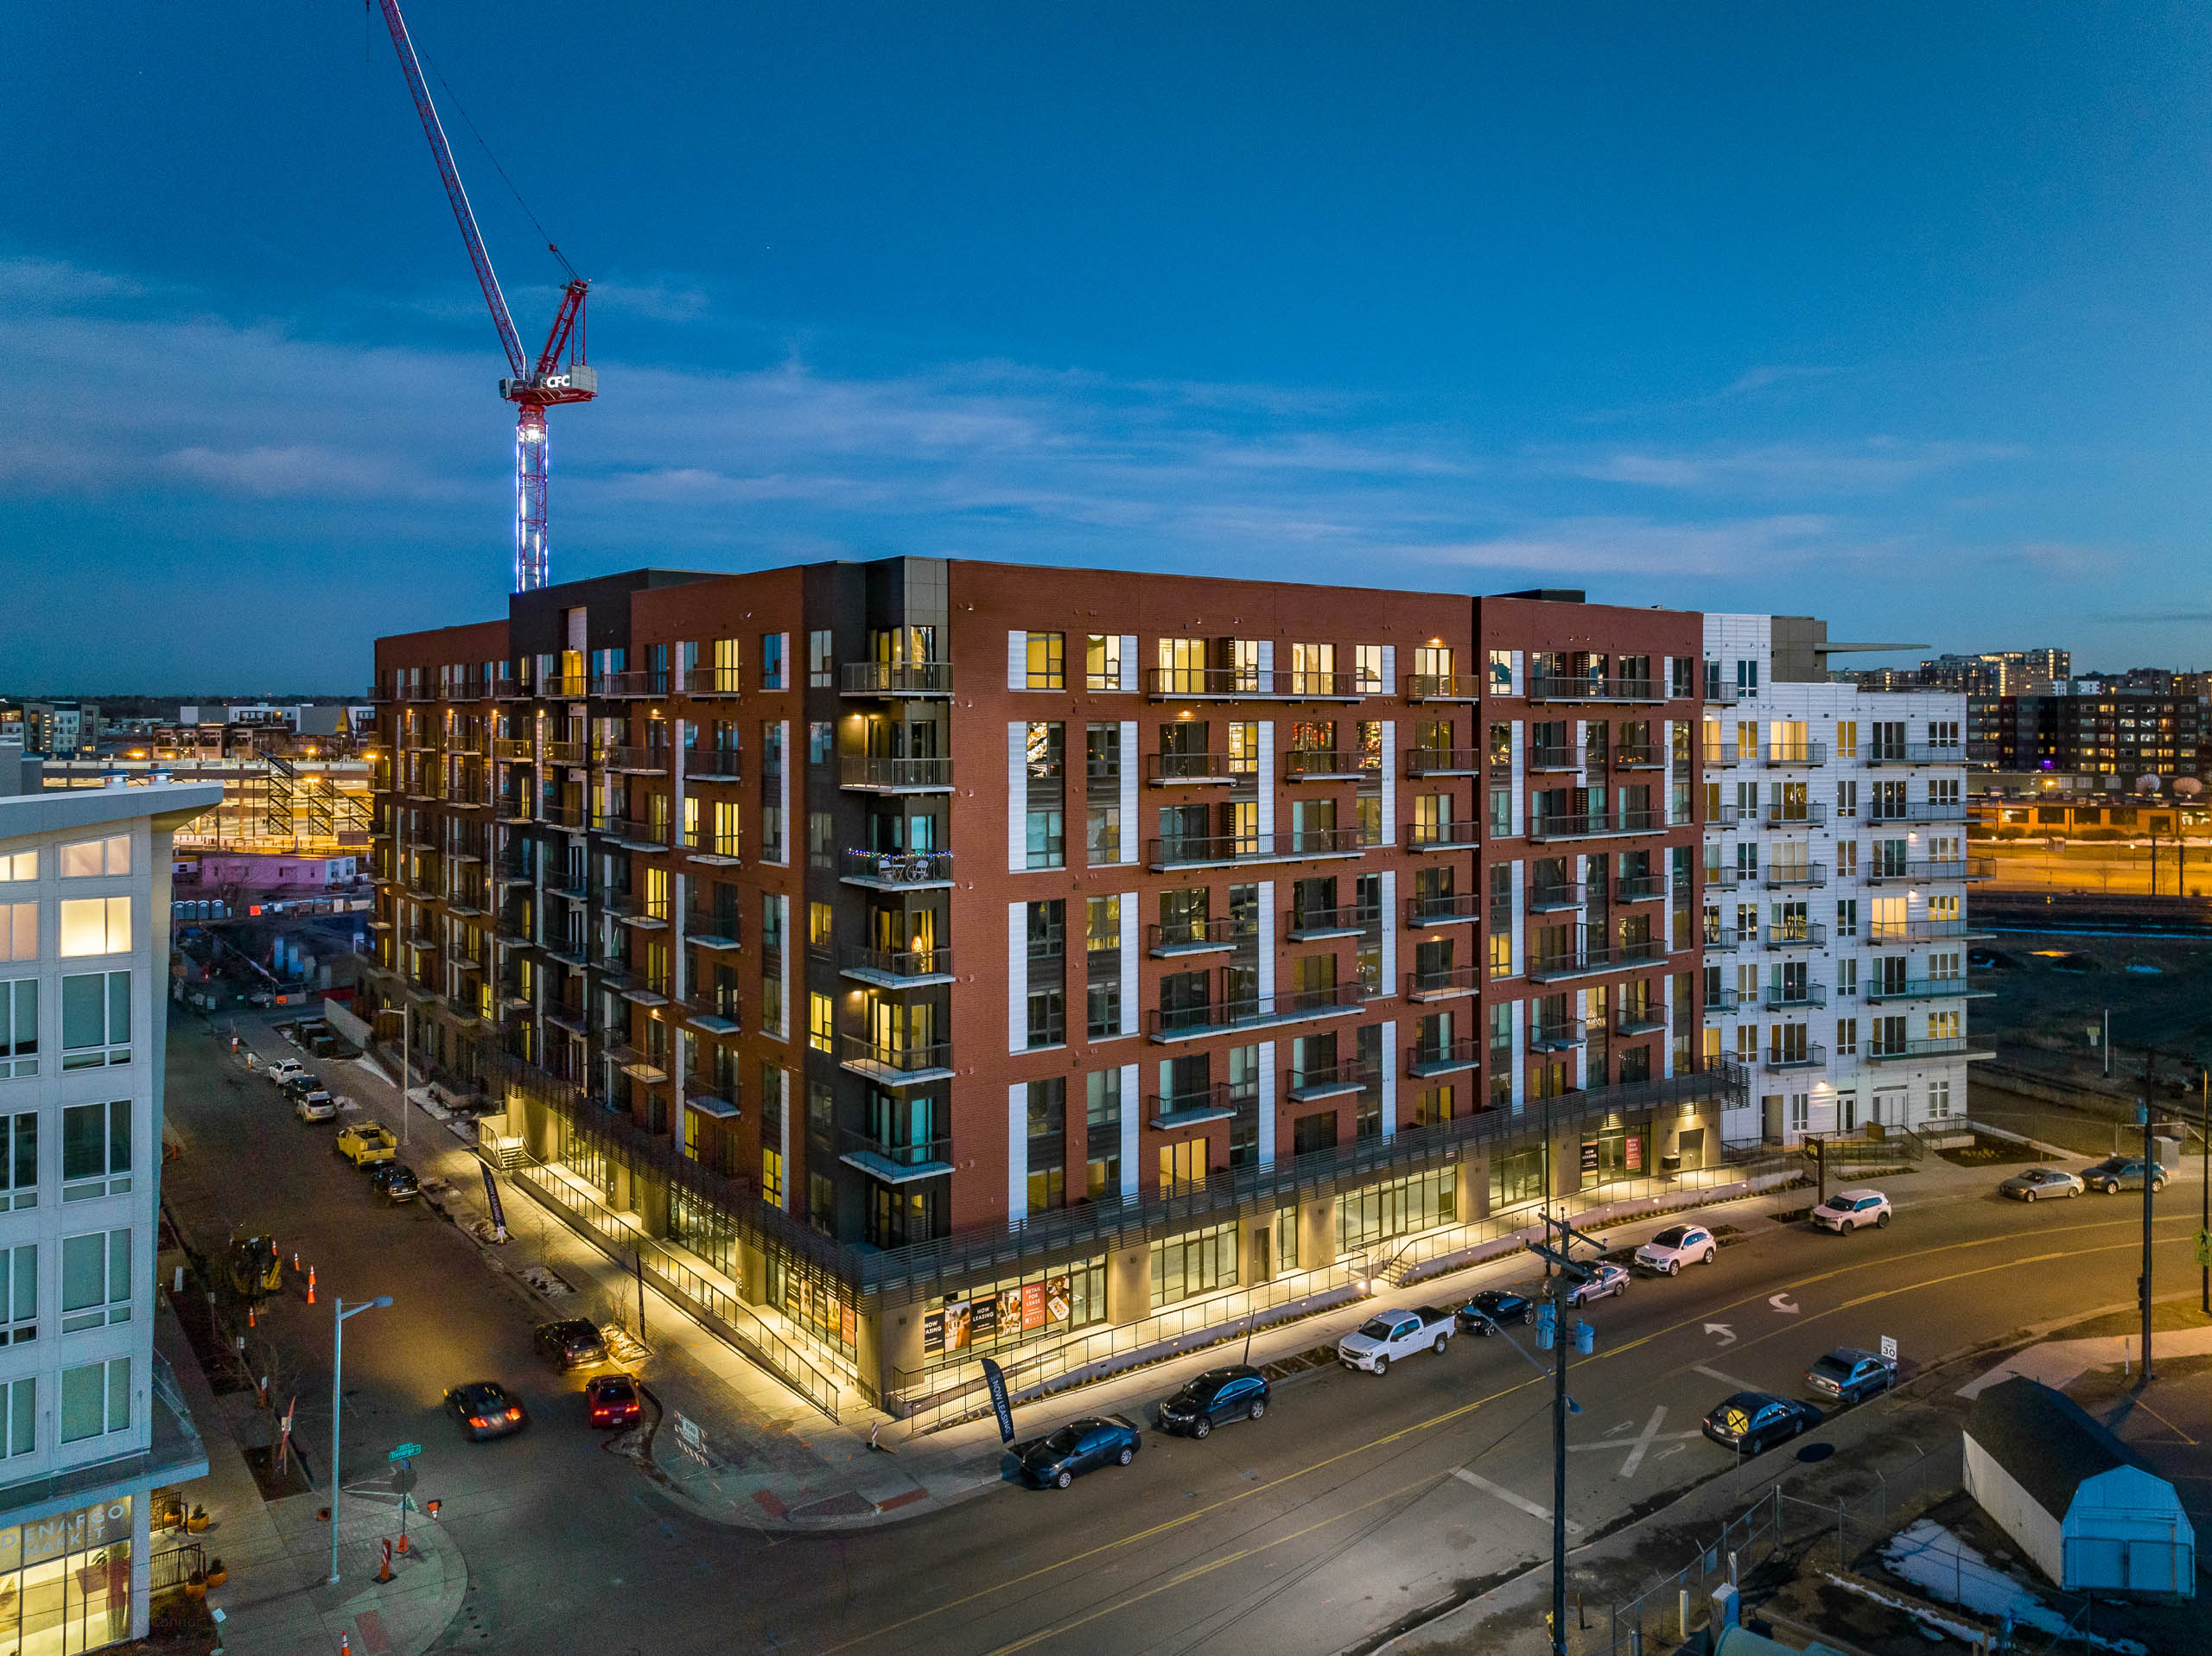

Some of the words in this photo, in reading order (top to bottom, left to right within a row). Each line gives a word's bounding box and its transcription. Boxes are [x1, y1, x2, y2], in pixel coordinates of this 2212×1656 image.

[546, 374, 570, 388] CFC
[487, 1178, 496, 1196] NOW
[491, 1196, 502, 1222] LEASING
[973, 1311, 995, 1323] LEASING
[976, 1306, 990, 1315] NOW
[925, 1325, 943, 1335] ASING
[1883, 1347, 1895, 1357] 30
[993, 1380, 1003, 1400] NOW
[997, 1399, 1012, 1434] LEASING
[685, 1422, 696, 1435] ROAD
[1, 1504, 124, 1549] DENARGO
